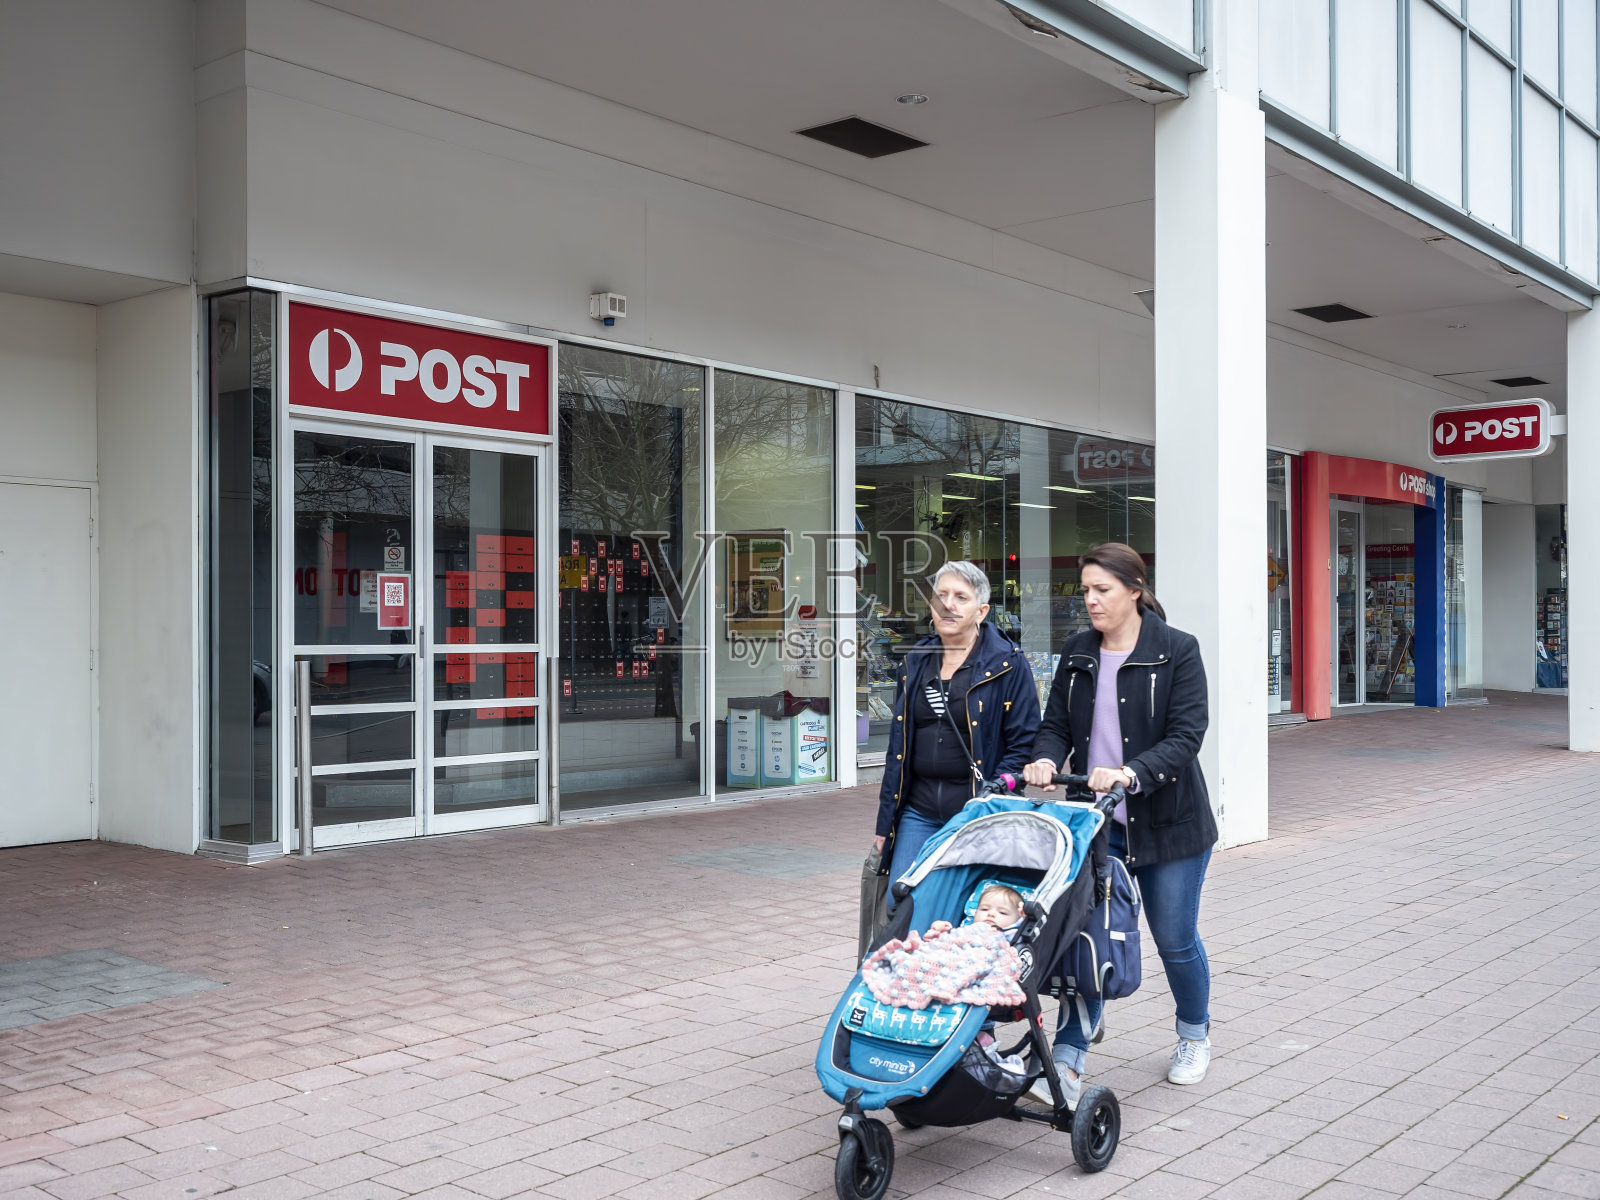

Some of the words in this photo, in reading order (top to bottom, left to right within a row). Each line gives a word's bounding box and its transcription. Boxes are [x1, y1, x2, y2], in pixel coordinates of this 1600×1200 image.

[380, 341, 530, 412] POST
[1464, 416, 1538, 442] POST
[1392, 544, 1409, 552] Cards
[869, 1056, 883, 1067] city
[883, 1060, 900, 1070] mini
